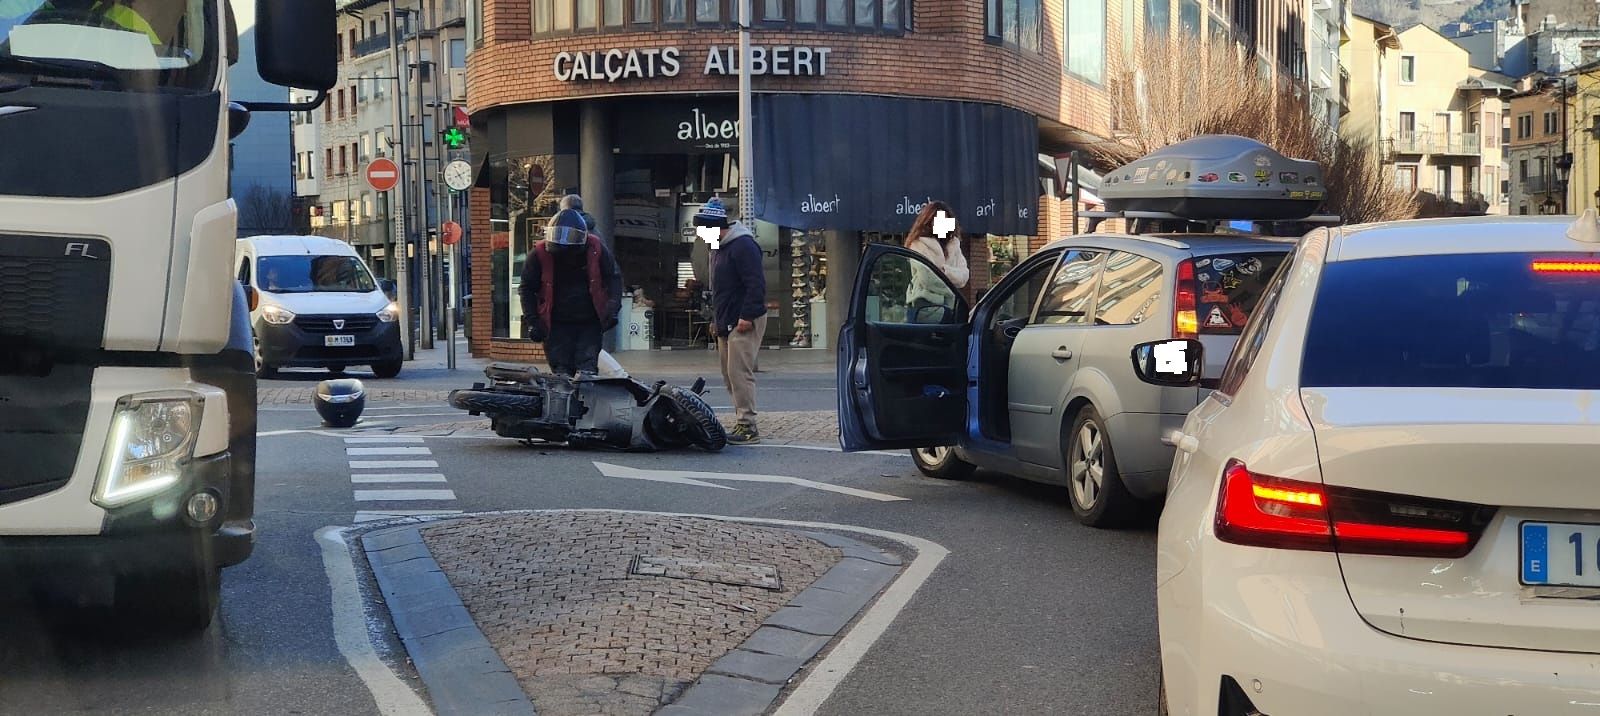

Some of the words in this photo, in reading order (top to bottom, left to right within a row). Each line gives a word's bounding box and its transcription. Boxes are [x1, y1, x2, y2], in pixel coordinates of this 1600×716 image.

[553, 46, 681, 83] CALÇATS
[703, 45, 832, 77] ALBERT
[677, 108, 740, 140] alber
[801, 193, 841, 213] albert
[64, 242, 98, 259] FL
[1531, 559, 1541, 573] E
[1568, 532, 1600, 577] 1
